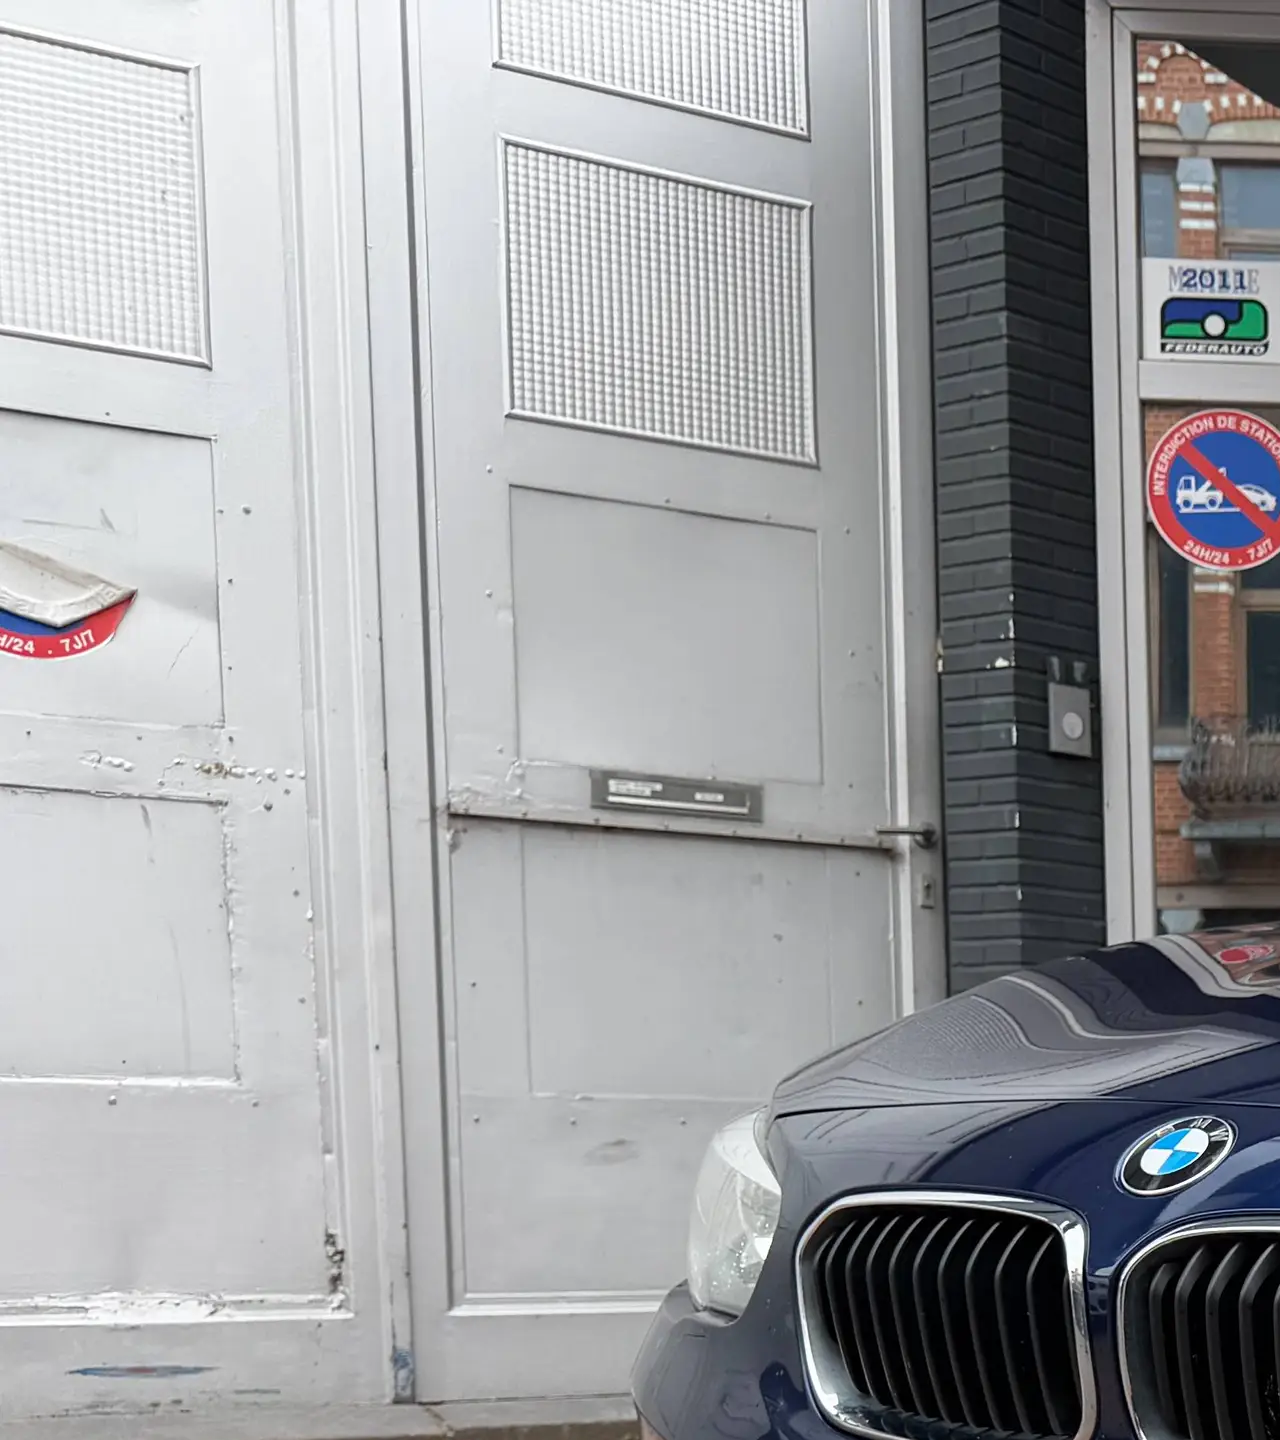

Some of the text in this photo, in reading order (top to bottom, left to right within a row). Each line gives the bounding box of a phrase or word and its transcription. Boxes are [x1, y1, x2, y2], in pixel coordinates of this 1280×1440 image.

[1182, 268, 1247, 291] 2011
[1164, 342, 1267, 355] FEDERAUTO
[1153, 416, 1214, 496] INTERDICTION
[1216, 415, 1236, 432] DE
[1182, 539, 1230, 565] 24H/24
[1157, 1117, 1230, 1142] BMW
